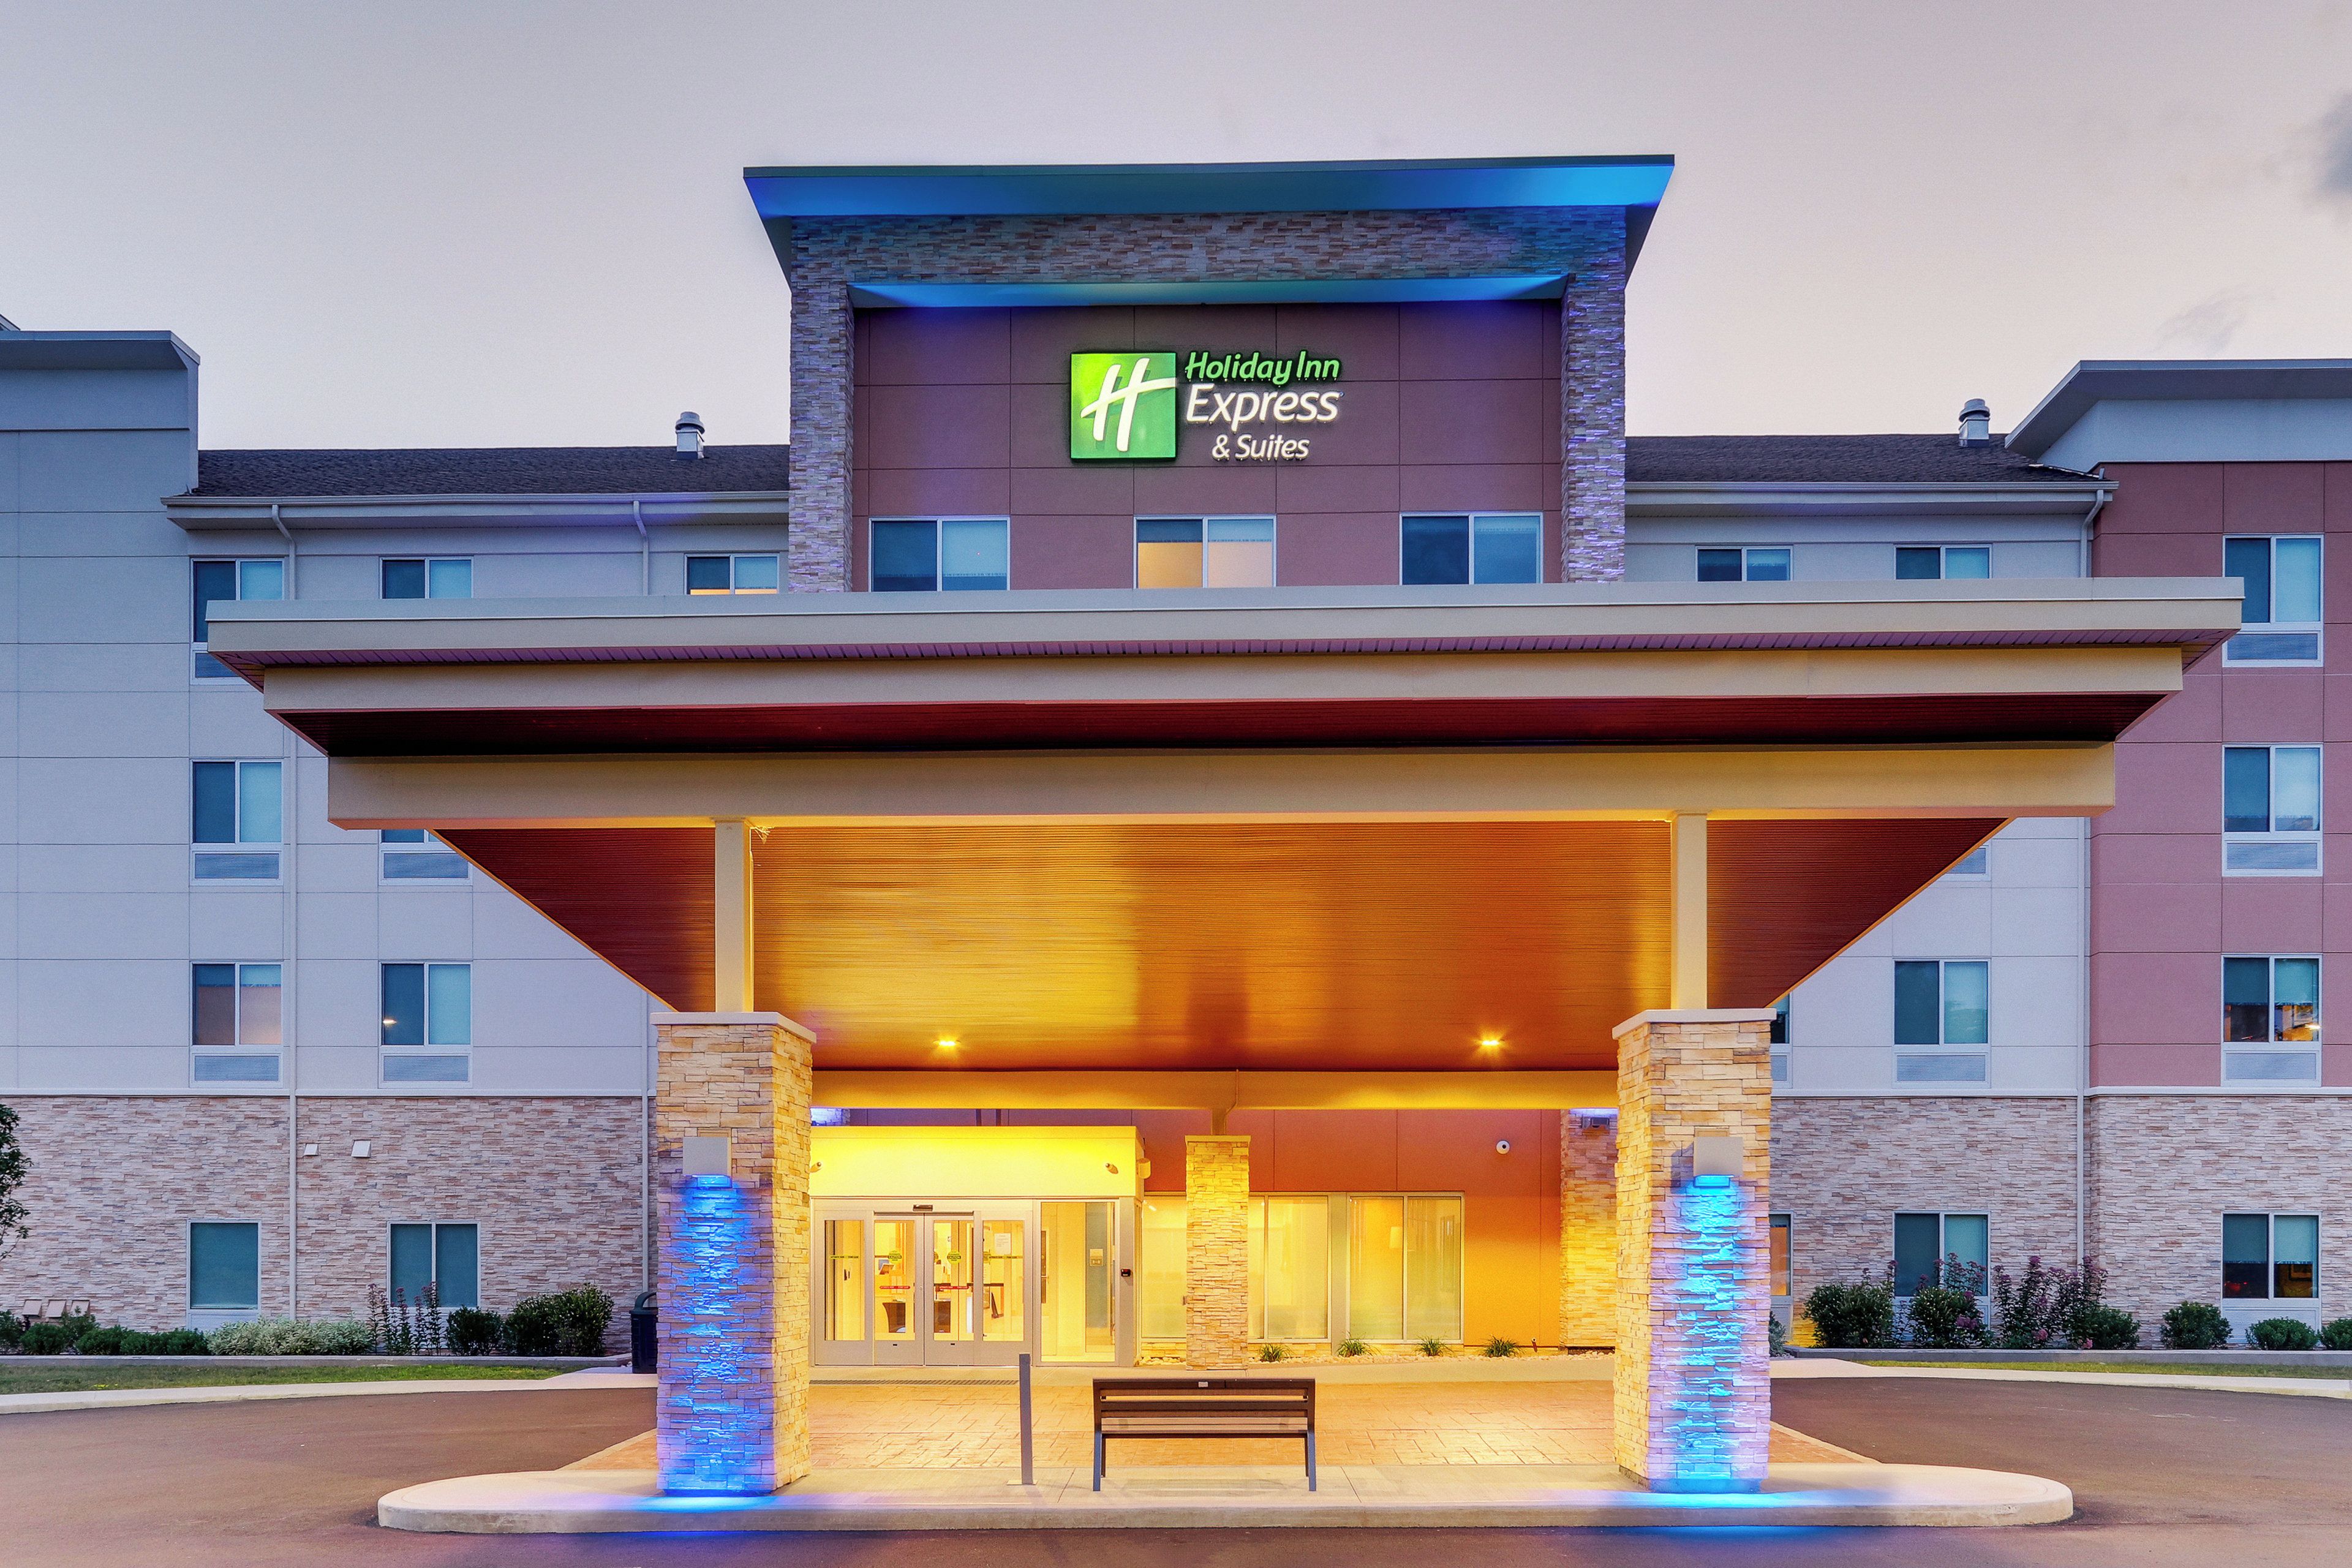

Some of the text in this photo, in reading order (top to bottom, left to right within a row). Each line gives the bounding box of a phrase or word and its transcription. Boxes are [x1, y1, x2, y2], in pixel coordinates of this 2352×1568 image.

[1185, 351, 1340, 385] Holiday Inn
[1186, 383, 1341, 432] Express
[1212, 434, 1310, 458] & Suites
